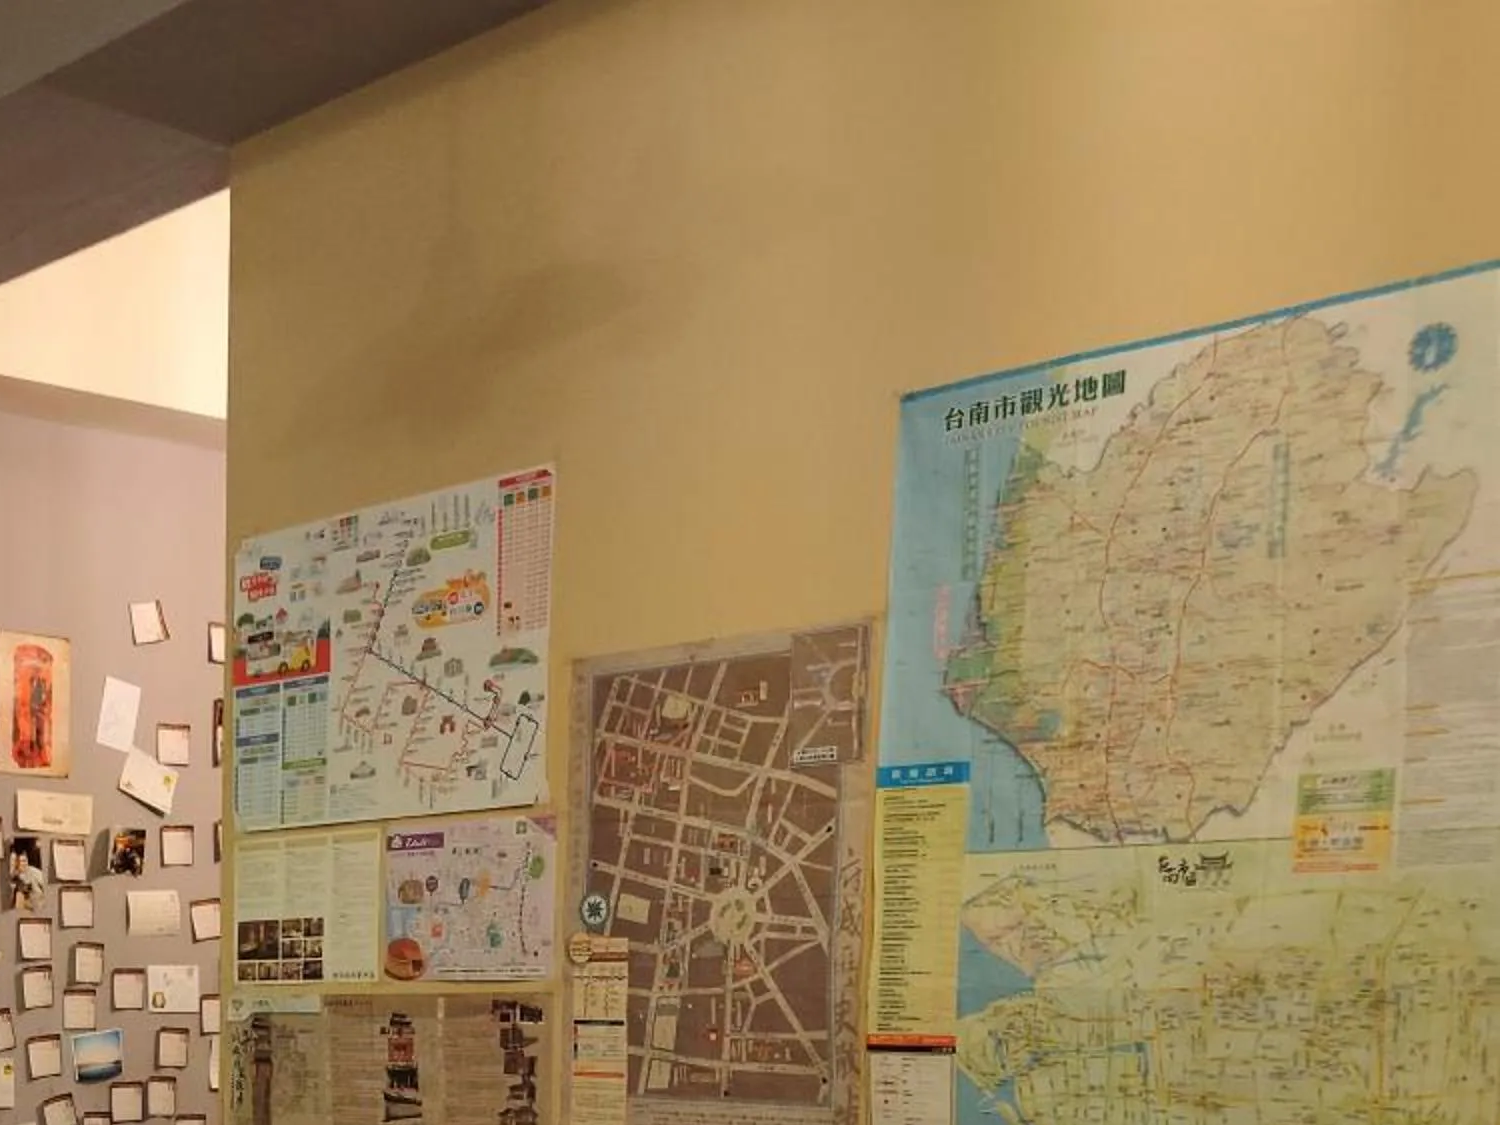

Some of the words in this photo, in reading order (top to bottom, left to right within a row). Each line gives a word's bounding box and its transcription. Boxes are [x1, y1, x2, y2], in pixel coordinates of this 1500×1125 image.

[944, 370, 1127, 432] 台南市觀光地圖
